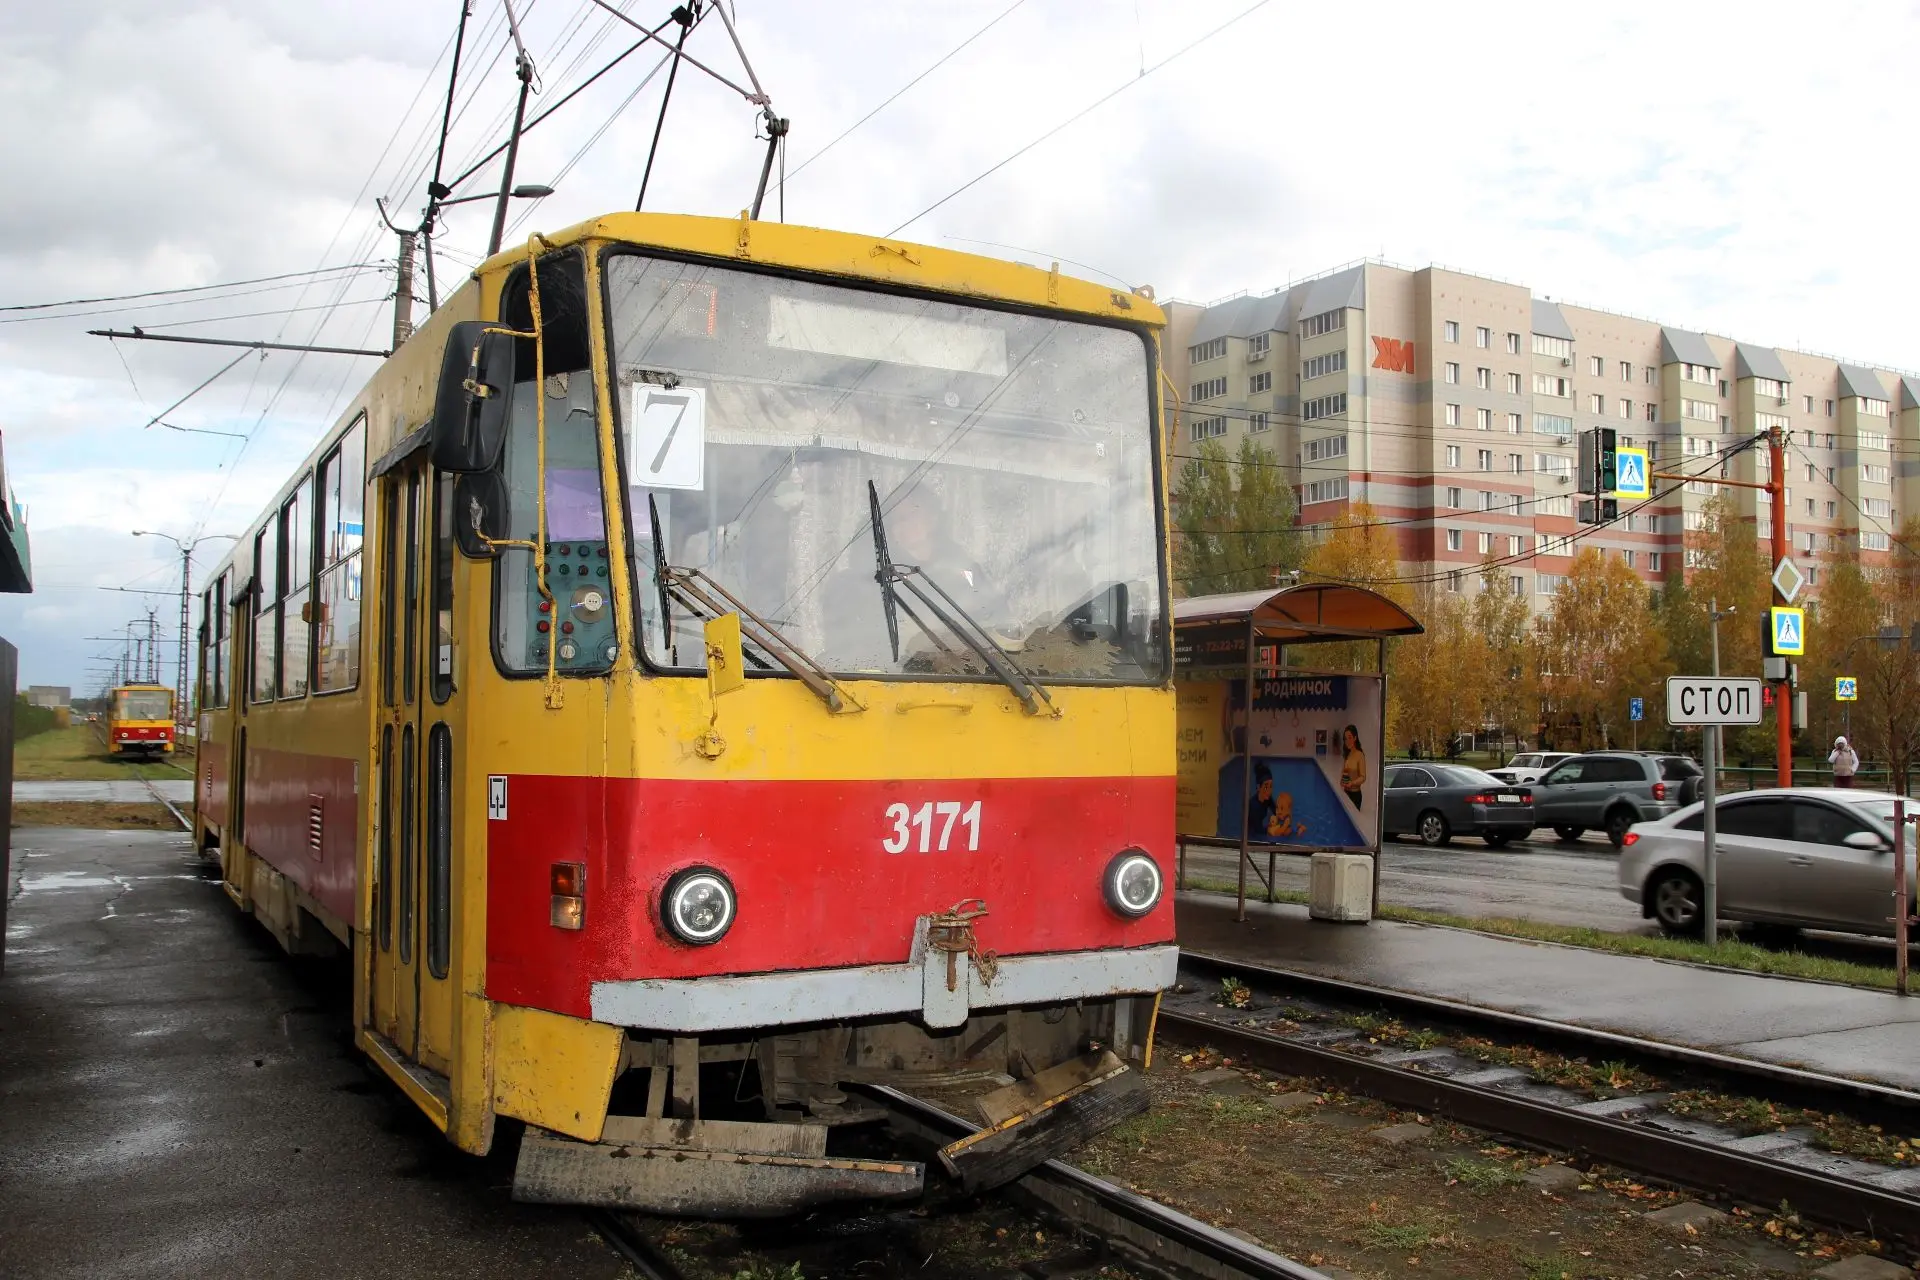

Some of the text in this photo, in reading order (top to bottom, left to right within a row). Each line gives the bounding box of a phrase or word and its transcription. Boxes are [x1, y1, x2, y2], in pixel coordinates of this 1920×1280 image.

[643, 390, 691, 475] 7
[1264, 680, 1333, 699] РОДНИЧОК
[1680, 686, 1750, 716] СТОП
[882, 800, 982, 854] 3171
